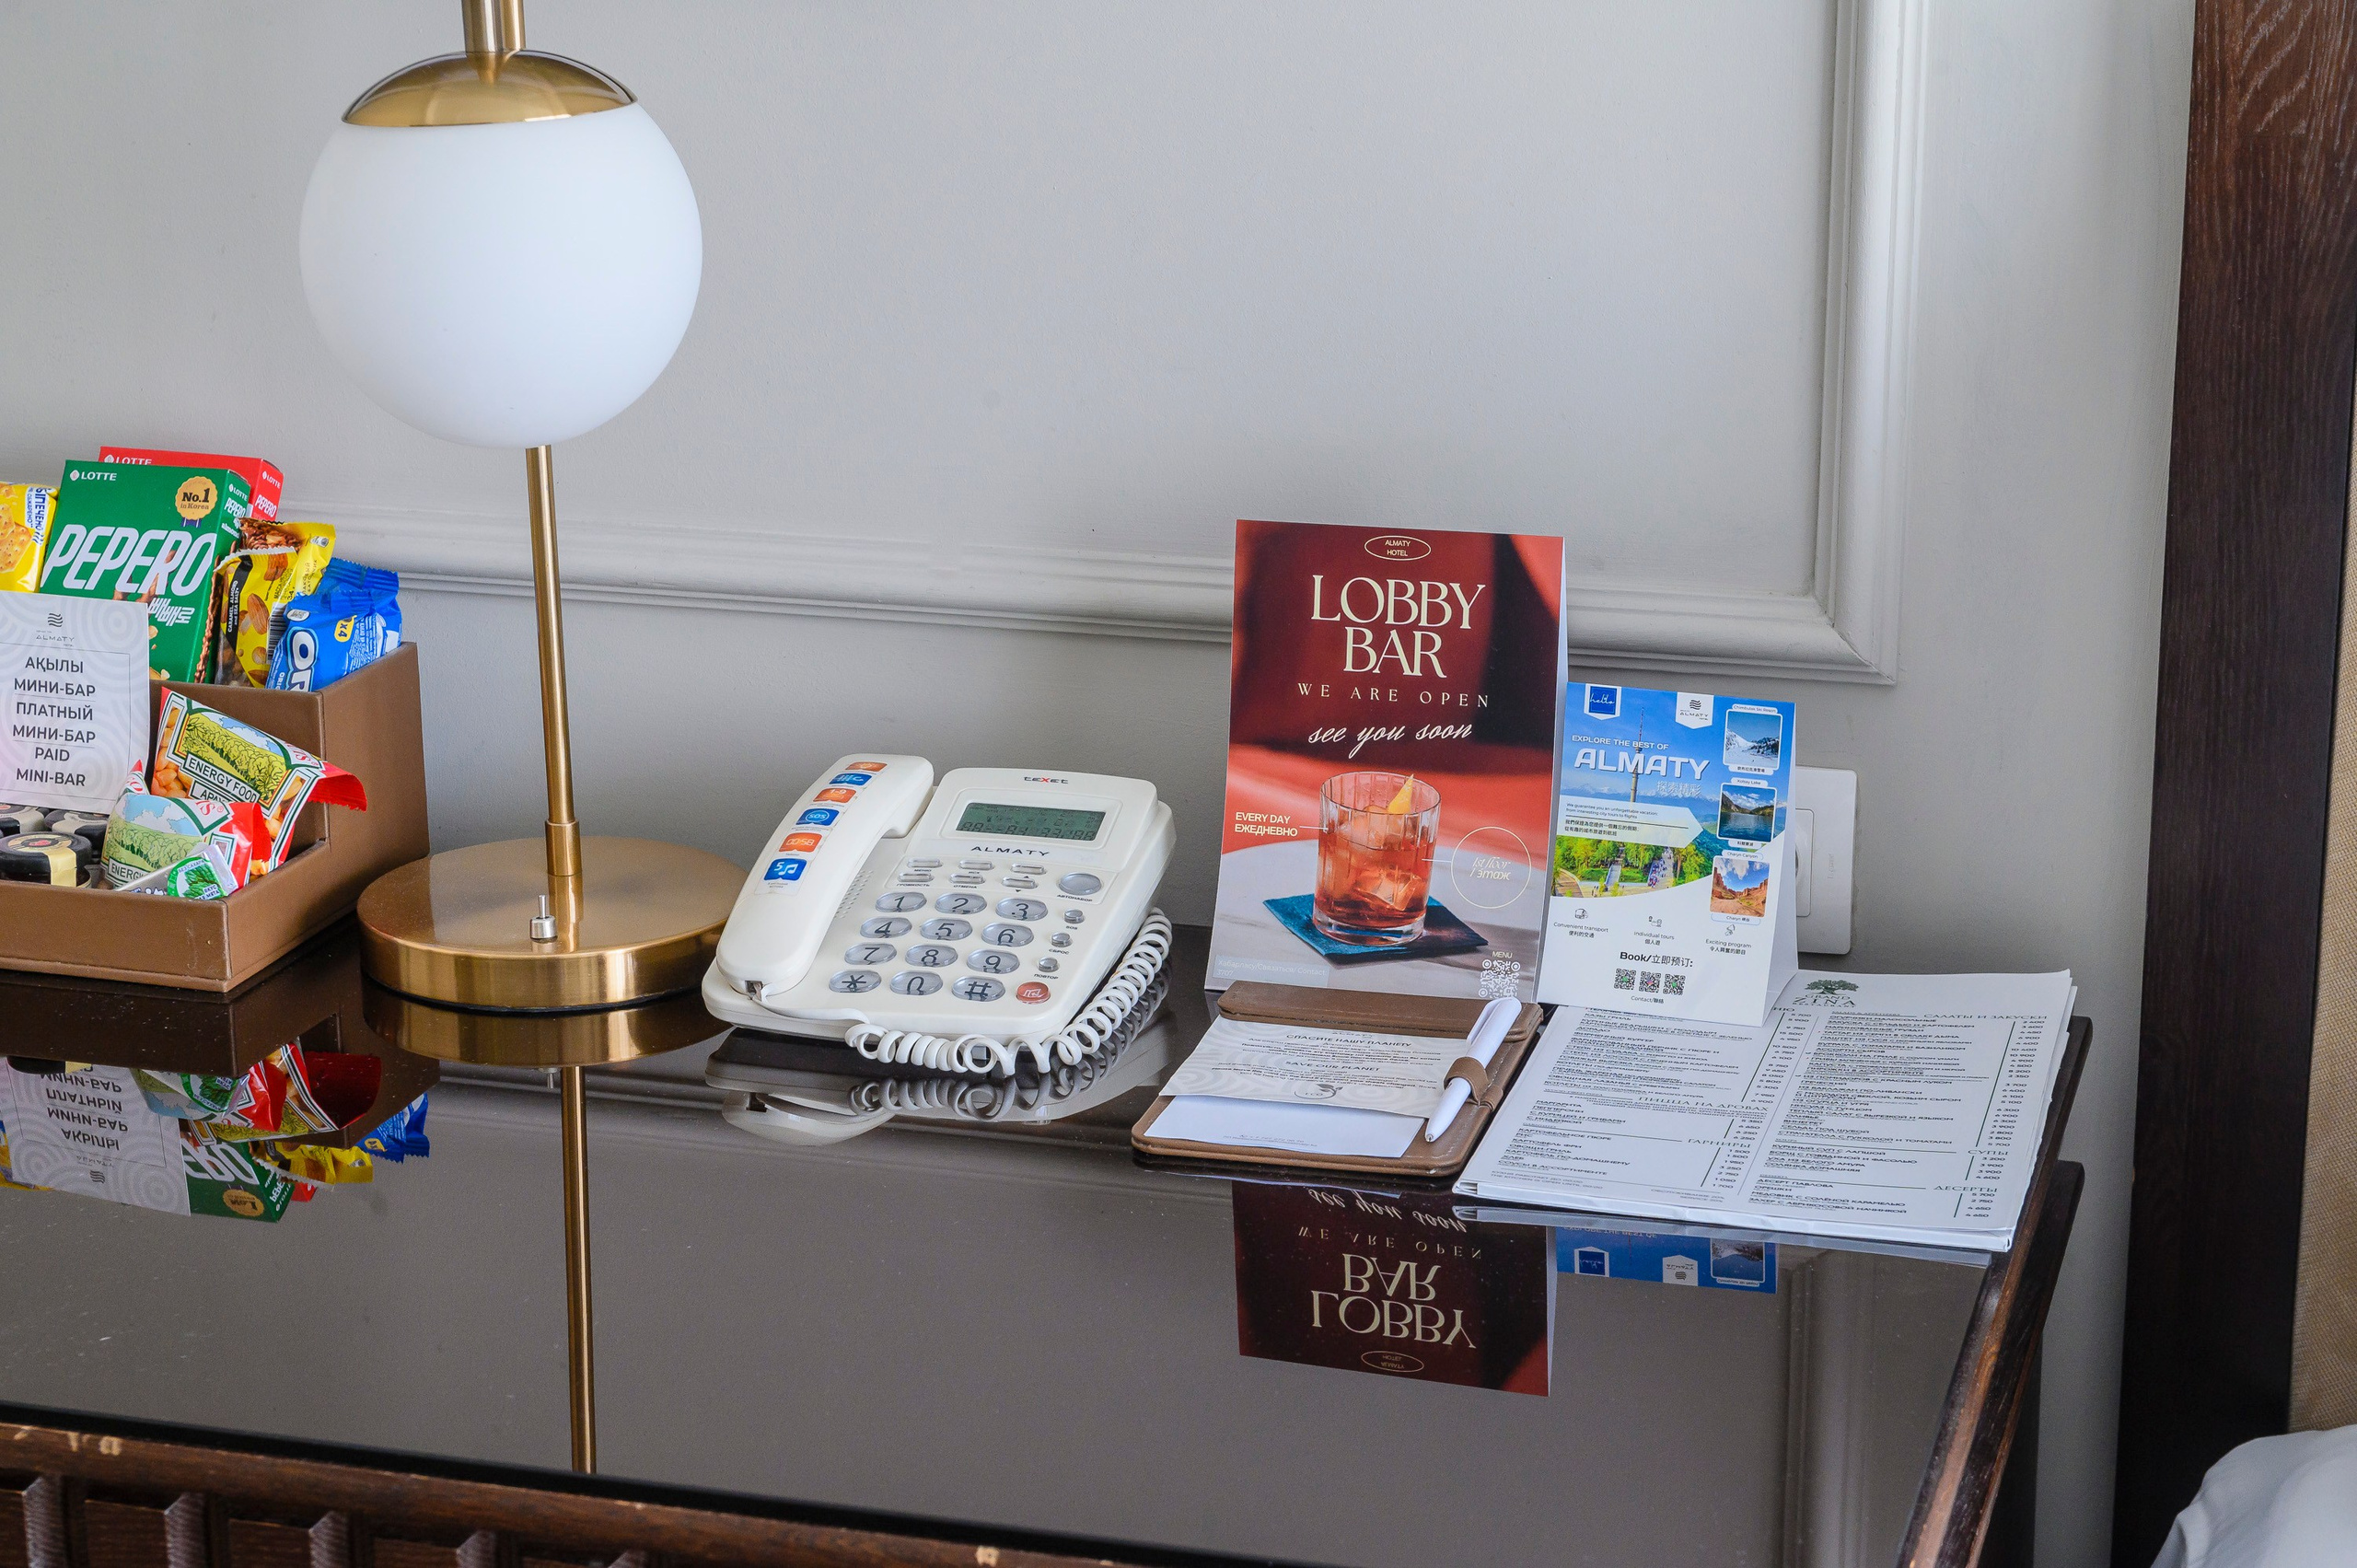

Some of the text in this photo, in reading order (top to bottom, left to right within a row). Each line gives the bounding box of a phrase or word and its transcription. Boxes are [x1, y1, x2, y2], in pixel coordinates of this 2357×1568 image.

[81, 471, 117, 482] LOTTE
[266, 474, 281, 489] LOTTE
[181, 488, 210, 503] No.1
[233, 487, 248, 502] LOTTE
[224, 497, 246, 517] PEPERO
[255, 494, 277, 517] PEPERO
[41, 524, 217, 596] PEPERO
[1310, 575, 1486, 629] LOBBY
[1343, 627, 1446, 679] BAR
[25, 656, 84, 674] АҚЫЛЫ
[291, 631, 314, 692] OR
[14, 678, 96, 696] МИНИ-БАР
[1298, 683, 1489, 707] WE ARE OPEN
[16, 701, 93, 721] ПЛАТНЫЙ
[13, 724, 96, 743] МИНИ-БАР
[1308, 723, 1472, 759] see you soon
[1572, 735, 1611, 745] EXPLORE
[1613, 738, 1631, 747] THE
[1632, 740, 1655, 749] BEST
[35, 747, 70, 762] PAID
[1573, 748, 1711, 781] ALMATY
[16, 768, 86, 787] MINI-BAR
[188, 757, 258, 803] ENERGY FOOD
[1236, 812, 1291, 824] EVERY DAY
[1611, 807, 1639, 815] unforgettable
[1235, 823, 1298, 837] ЕЖЕДНЕВНО
[970, 846, 1050, 856] ALMATY
[773, 862, 784, 871] 5
[203, 885, 216, 894] ВКУС
[952, 898, 969, 911] 2
[1057, 894, 1093, 902] АВТОНАБОР
[1016, 903, 1029, 916] 3
[874, 921, 892, 935] 4
[938, 923, 955, 936] 5
[998, 929, 1015, 944] 6
[864, 947, 880, 962] 7
[923, 949, 939, 965] 8
[985, 956, 1001, 970] 9
[1297, 968, 1326, 976] Contact
[1794, 997, 1856, 1005] ZINA
[1688, 1138, 1751, 1148] ГАРНИРЫ
